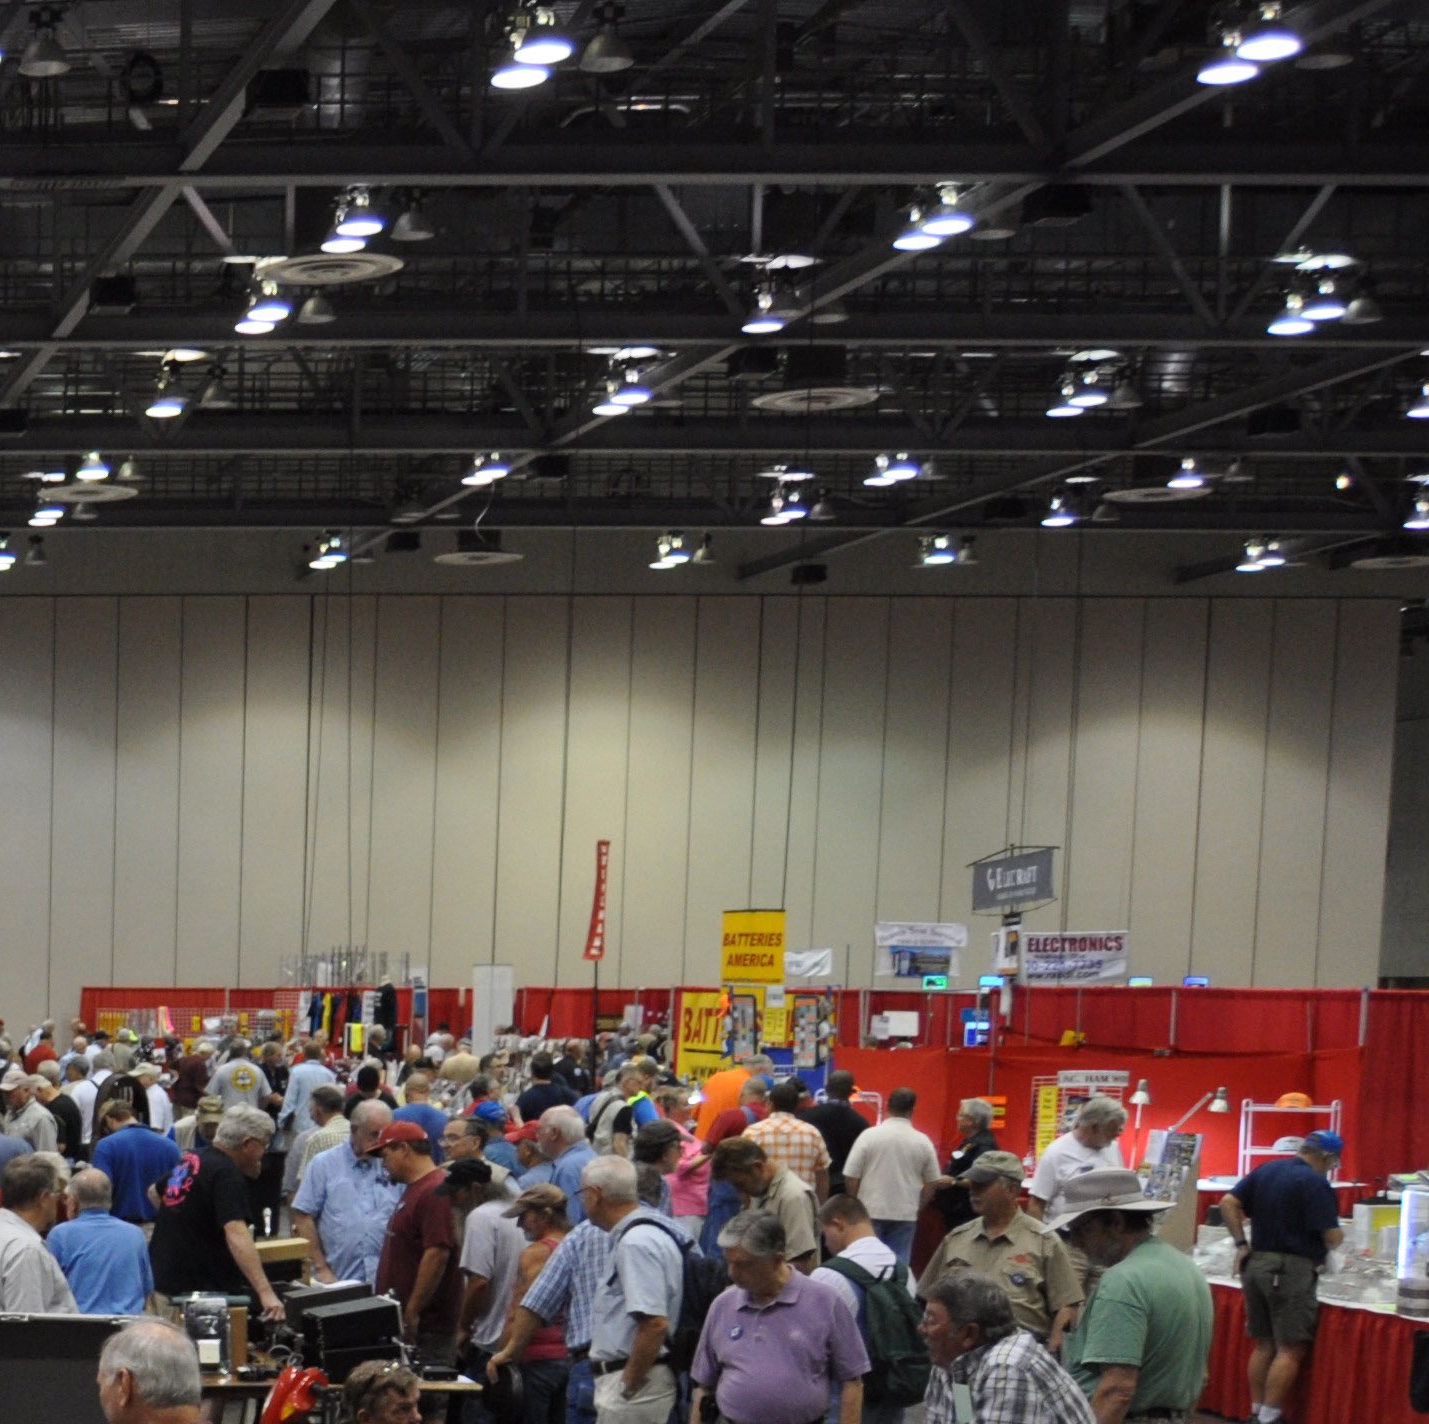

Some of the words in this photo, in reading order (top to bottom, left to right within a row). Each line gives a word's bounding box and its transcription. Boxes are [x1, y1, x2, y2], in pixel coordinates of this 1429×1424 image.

[723, 933, 782, 946] BATTERIES
[1028, 937, 1123, 953] ELECTRONICS
[727, 954, 775, 967] AMERICA
